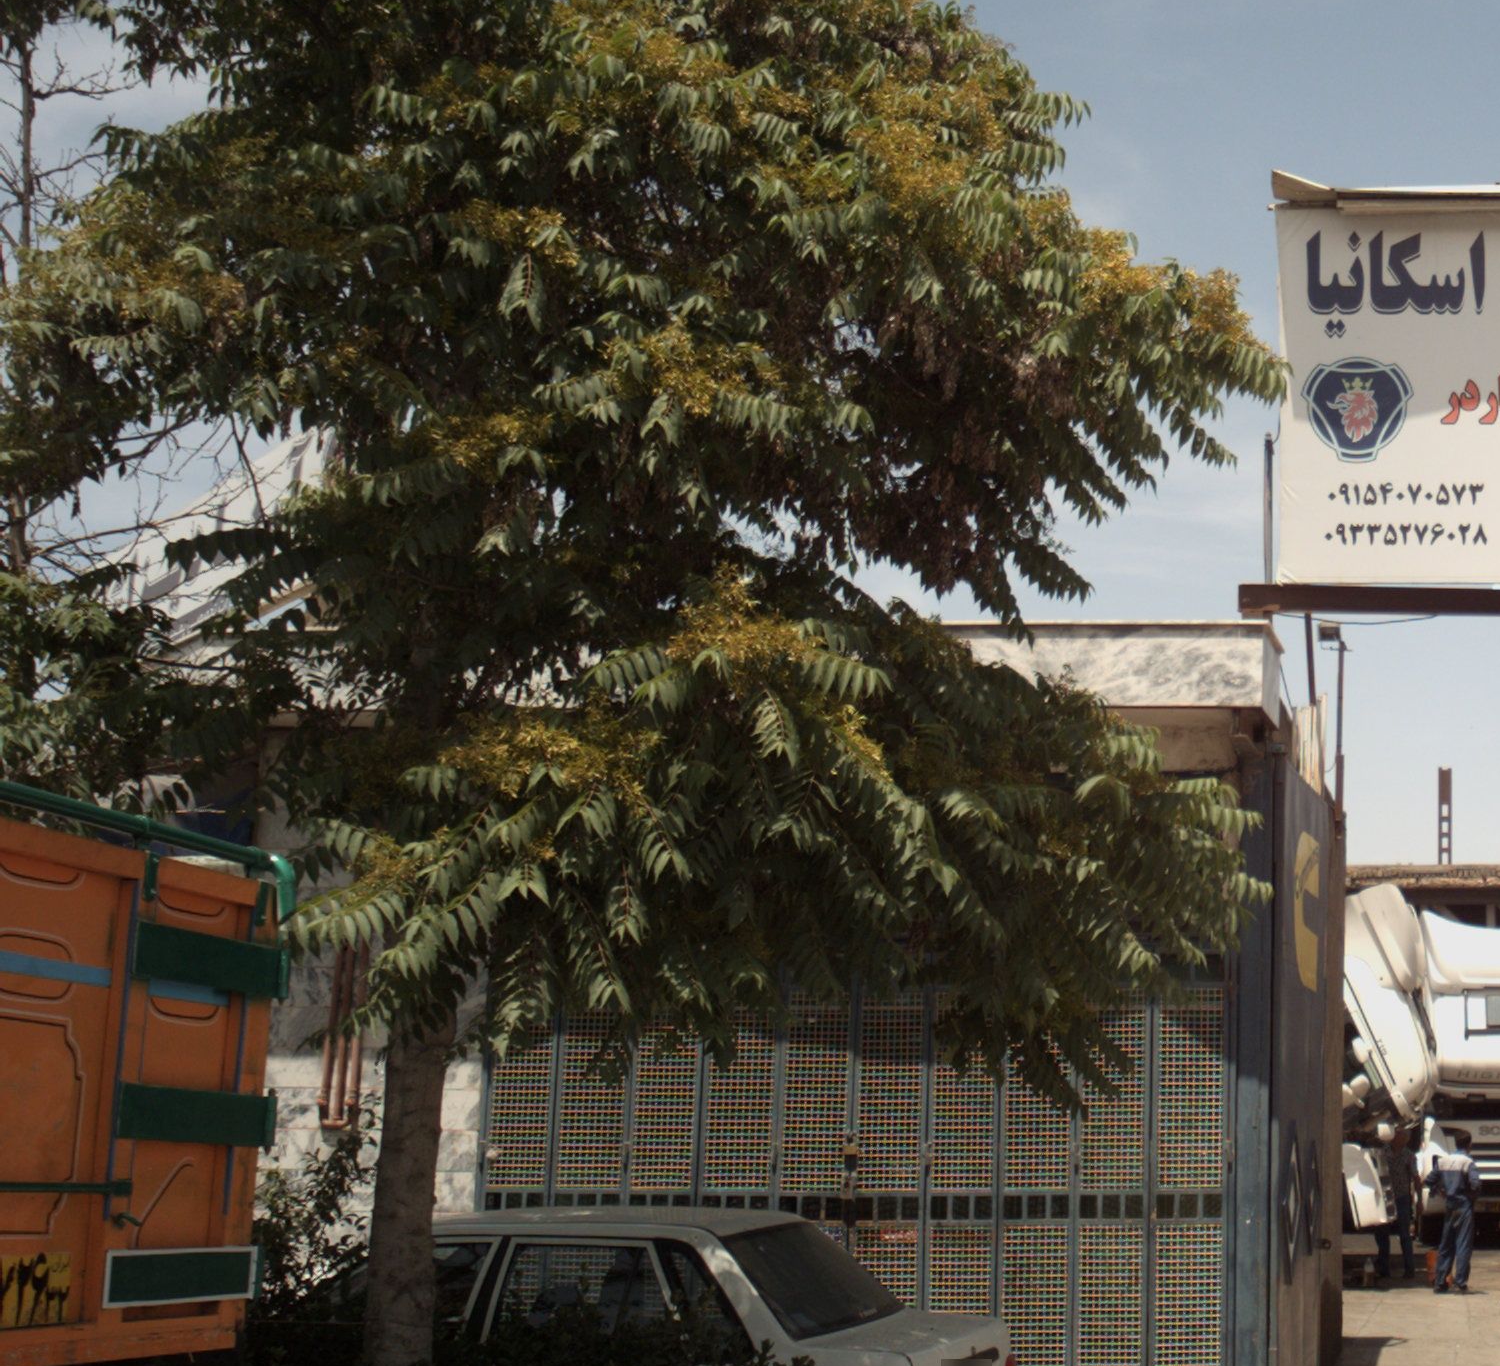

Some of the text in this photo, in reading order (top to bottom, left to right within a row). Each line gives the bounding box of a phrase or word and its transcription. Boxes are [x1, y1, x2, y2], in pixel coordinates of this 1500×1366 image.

[1306, 230, 1486, 339] اسکانیا
[1327, 482, 1485, 506] ۰۹۱۵۴۰۷۰۵۷۳
[1324, 523, 1488, 546] ۰۹۳۳۵۲۷۶۰۲۸
